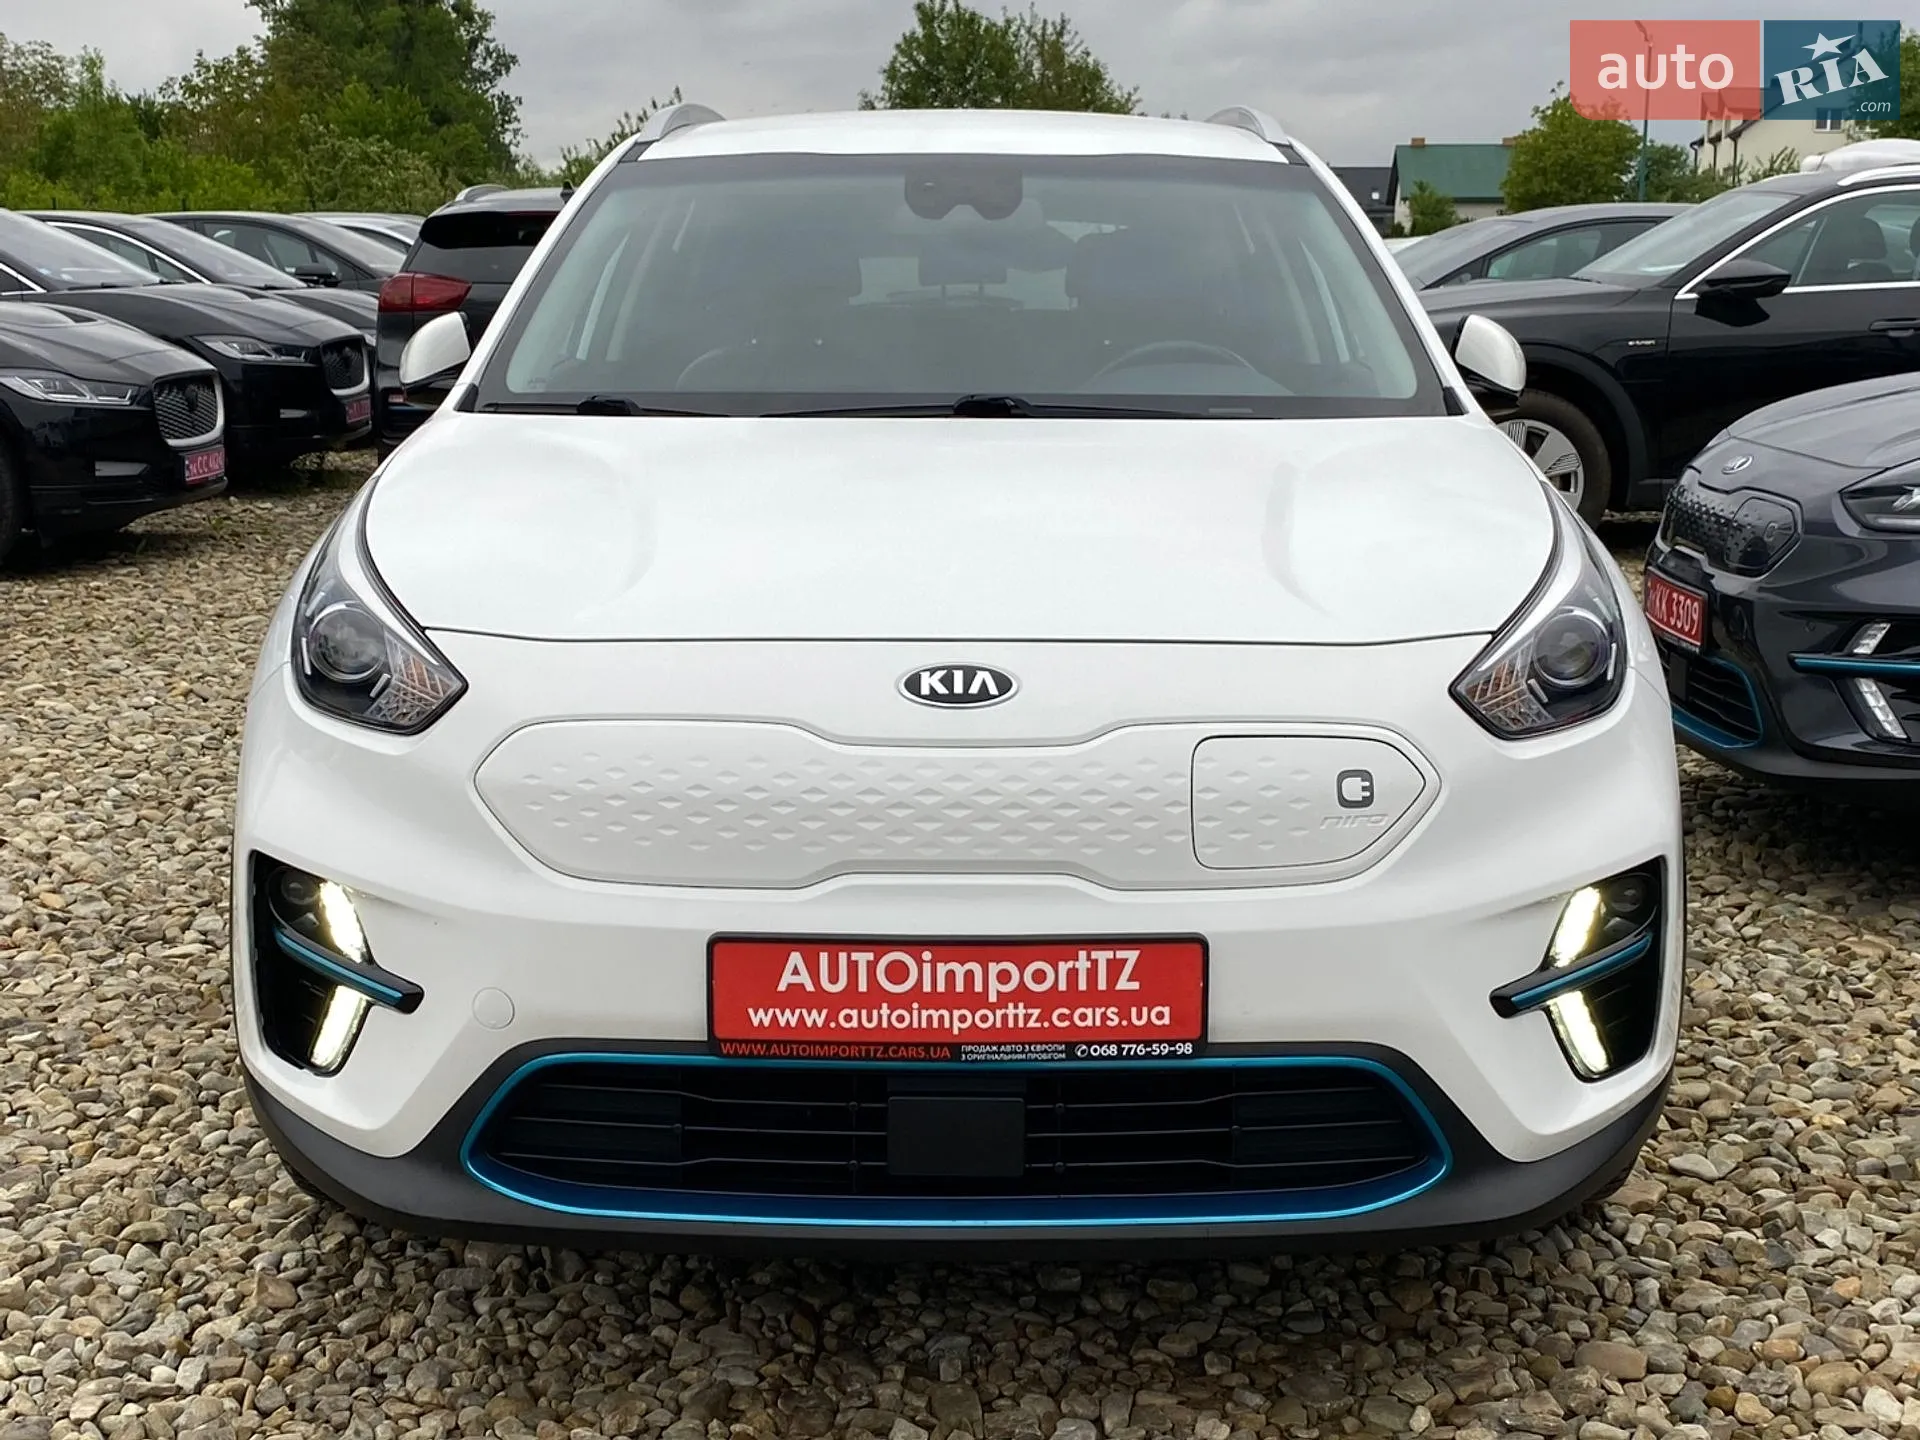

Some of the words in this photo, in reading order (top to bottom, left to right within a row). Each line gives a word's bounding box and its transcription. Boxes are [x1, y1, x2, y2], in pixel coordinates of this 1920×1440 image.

[1669, 591, 1700, 635] 3309
[919, 669, 999, 696] KIA
[776, 949, 1141, 1002] AUTOimportTZ
[747, 1002, 1171, 1035] www.autoimporttz.cars.ua
[719, 1042, 951, 1059] WWW.AUTOIMPORTTZ.CARS.UA
[1090, 1045, 1117, 1056] 068
[1121, 1043, 1193, 1056] 776-59-98
